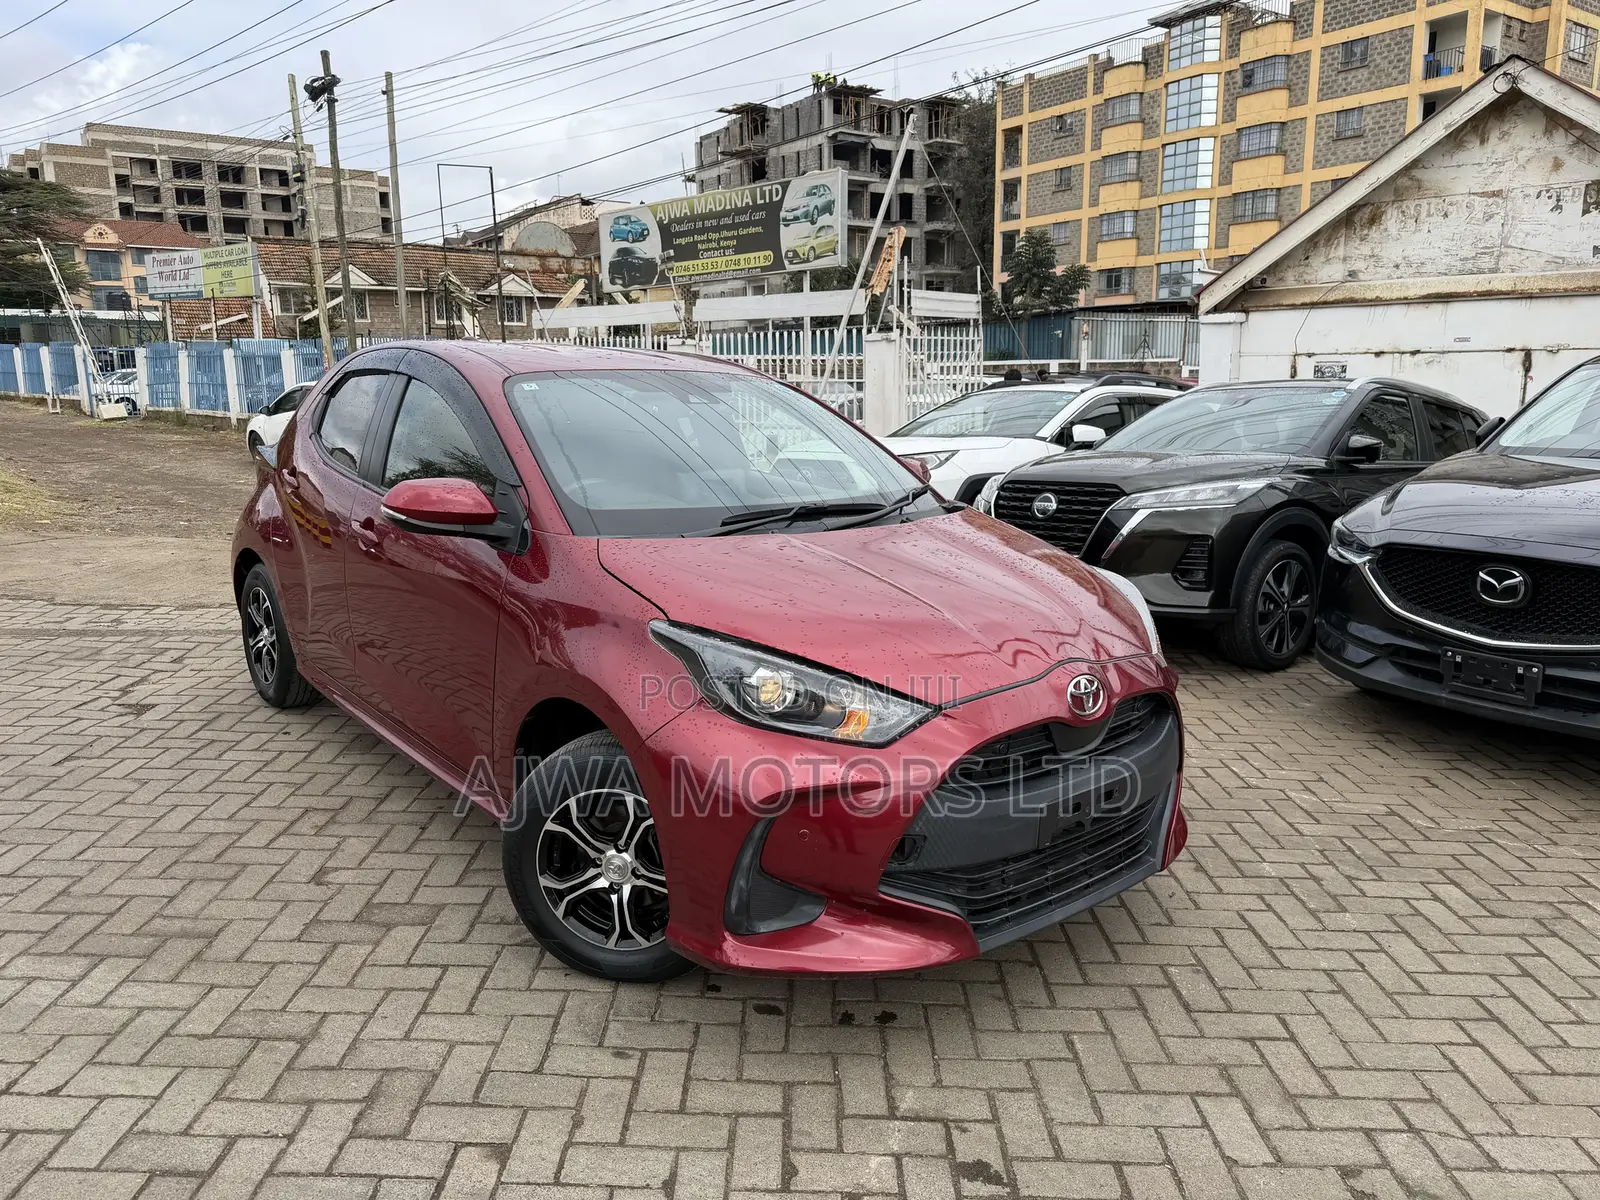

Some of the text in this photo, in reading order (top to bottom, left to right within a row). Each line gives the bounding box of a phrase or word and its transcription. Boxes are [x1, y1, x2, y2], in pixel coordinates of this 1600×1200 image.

[656, 184, 783, 224] AJWA MADINA LTD
[670, 209, 766, 232] Dealers in new and used cars
[673, 236, 693, 245] Langata
[694, 232, 707, 242] Road
[738, 226, 764, 236] Gardens,
[697, 239, 737, 250] Nairobi, Kenya
[204, 246, 248, 259] MULTIPLE CAR LOAN
[699, 248, 735, 259] Contact us:
[152, 254, 194, 268] Premier Auto
[675, 264, 690, 274] 0746
[691, 263, 699, 271] 51
[701, 261, 709, 270] 53
[710, 260, 719, 269] 53
[724, 257, 741, 268] 0748
[743, 256, 751, 265] 10
[753, 255, 761, 263] 11
[763, 254, 772, 263] 90
[158, 269, 190, 282] World Ltd
[221, 270, 233, 279] HERE
